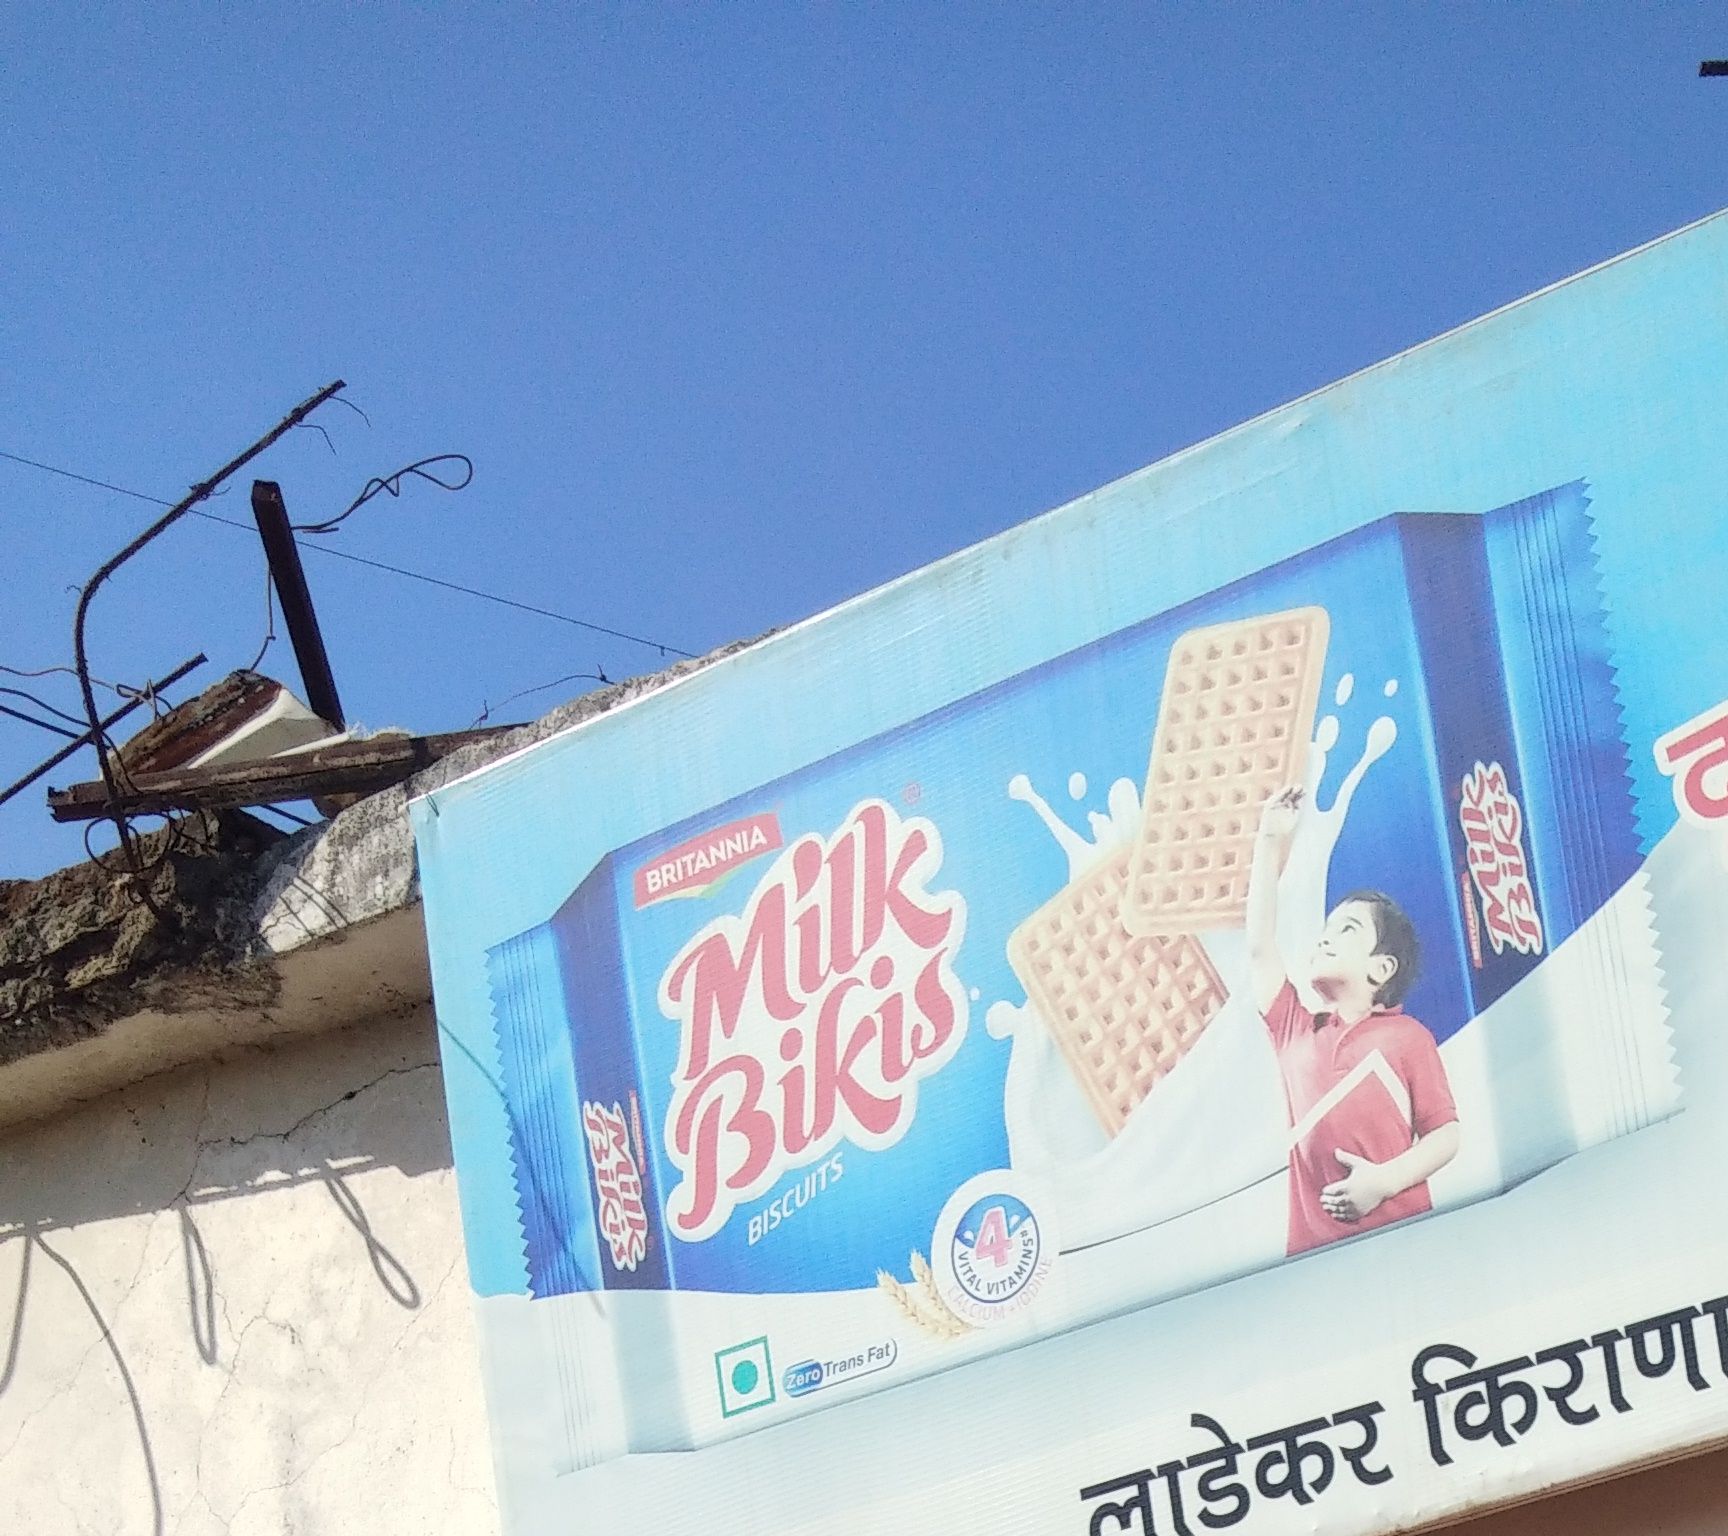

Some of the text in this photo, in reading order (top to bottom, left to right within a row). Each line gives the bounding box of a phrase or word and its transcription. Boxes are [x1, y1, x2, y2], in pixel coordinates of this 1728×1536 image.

[645, 826, 767, 894] BRITANNIA
[668, 804, 954, 1230] Milk Bikis
[747, 1151, 844, 1245] BISCUITS
[975, 1207, 1013, 1268] 4
[958, 1251, 982, 1292] VITAL
[786, 1342, 892, 1389] Zero Trans Fat
